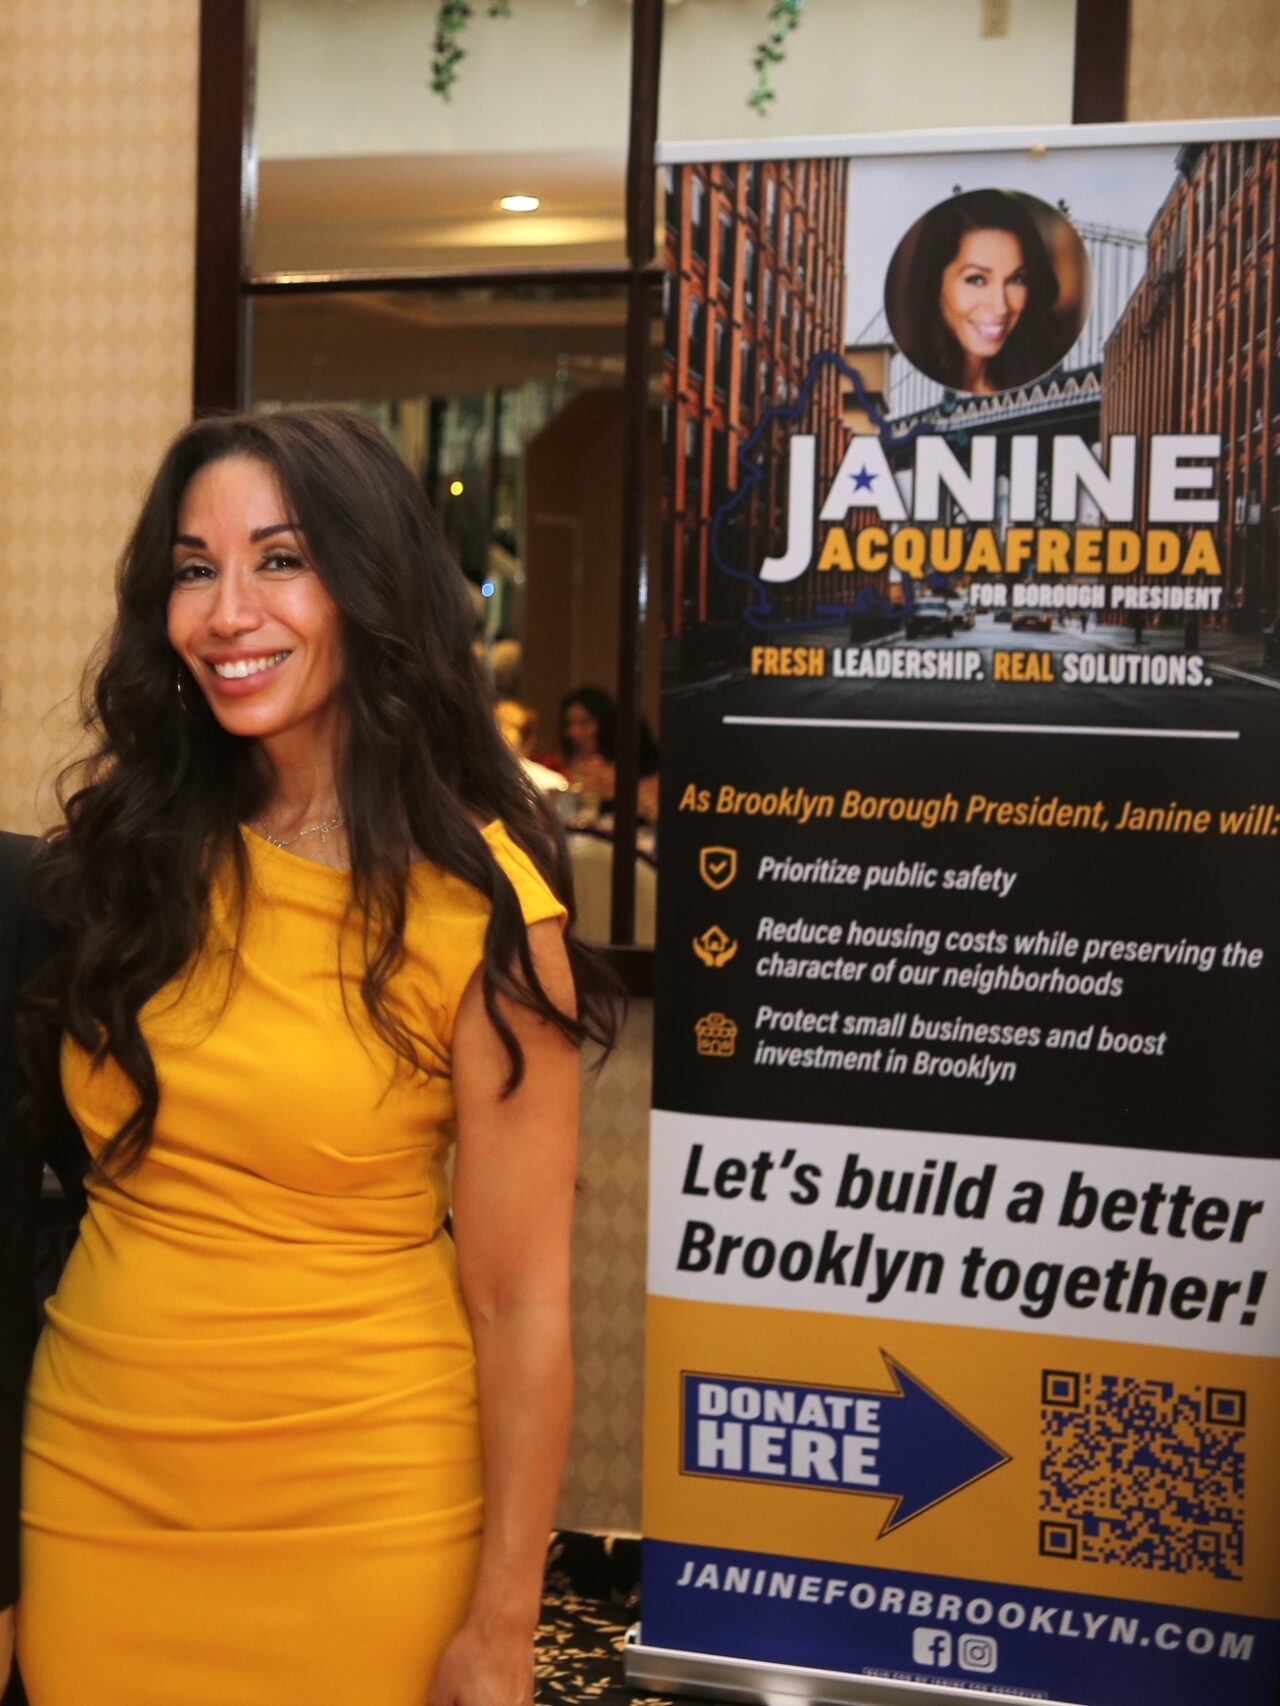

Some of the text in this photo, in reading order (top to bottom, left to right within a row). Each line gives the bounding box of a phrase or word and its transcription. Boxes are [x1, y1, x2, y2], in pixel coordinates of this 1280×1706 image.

[759, 434, 1221, 583] JANINE
[818, 527, 1222, 577] ACQUAFREDDA
[970, 583, 1222, 610] FOR BOROUGH PRESIDENT
[751, 645, 1213, 686] FRESH LEADERSHIP. REAL SOLUTIONS.
[679, 784, 1280, 836] As Brooklyn Borough President, Janine will:
[758, 857, 1017, 897] Prioritize public safety
[757, 917, 1263, 971] Reduce housing costs while preserving the
[756, 952, 1123, 997] character of our neighborhoods
[755, 1006, 1167, 1055] Protect small businesses and boost
[755, 1041, 1017, 1085] investment in Brooklyn
[681, 1143, 1264, 1243] Let's build a better
[676, 1221, 1267, 1326] Brooklyn together!
[697, 1383, 880, 1433] DONATE
[697, 1420, 880, 1486] HERE
[677, 1561, 1255, 1661] JANINEFORBROOKLYN.COM
